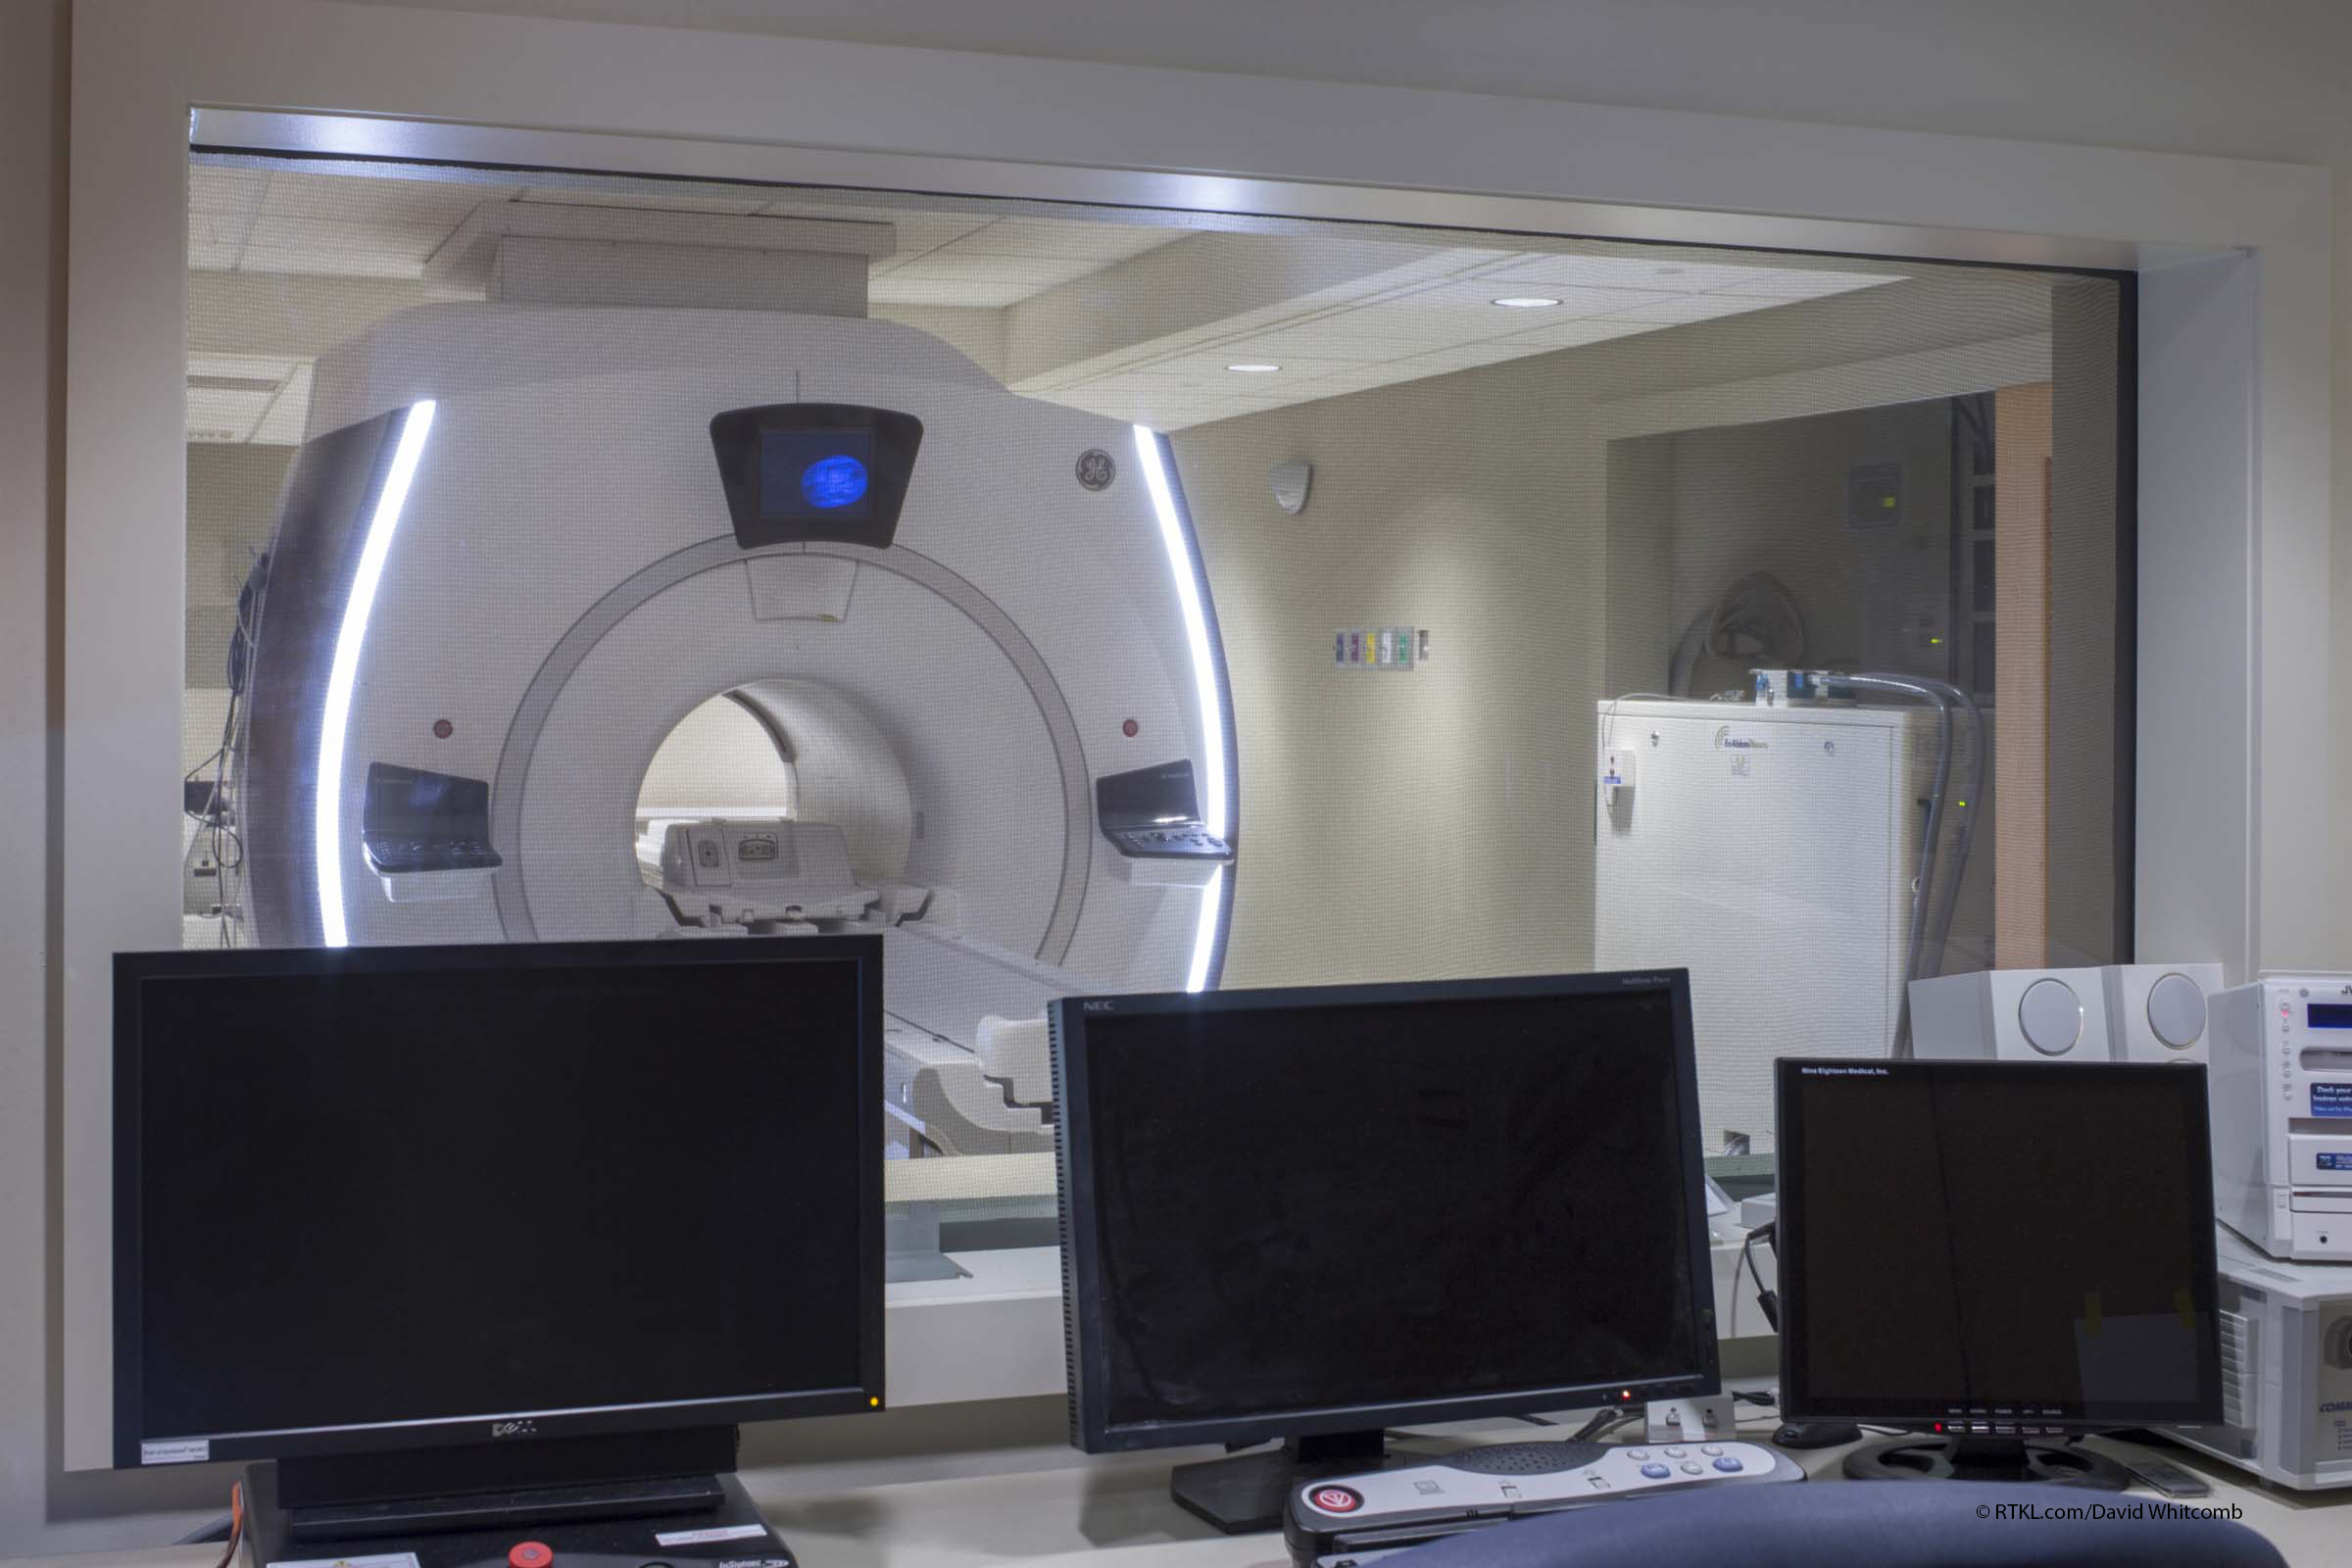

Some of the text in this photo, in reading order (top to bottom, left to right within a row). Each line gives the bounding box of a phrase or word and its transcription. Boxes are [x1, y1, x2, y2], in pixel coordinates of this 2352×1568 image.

[1079, 453, 1112, 486] GE
[1083, 1001, 1114, 1010] NEC
[1801, 1066, 1817, 1075] Nine
[1818, 1066, 1847, 1076] Eighteen
